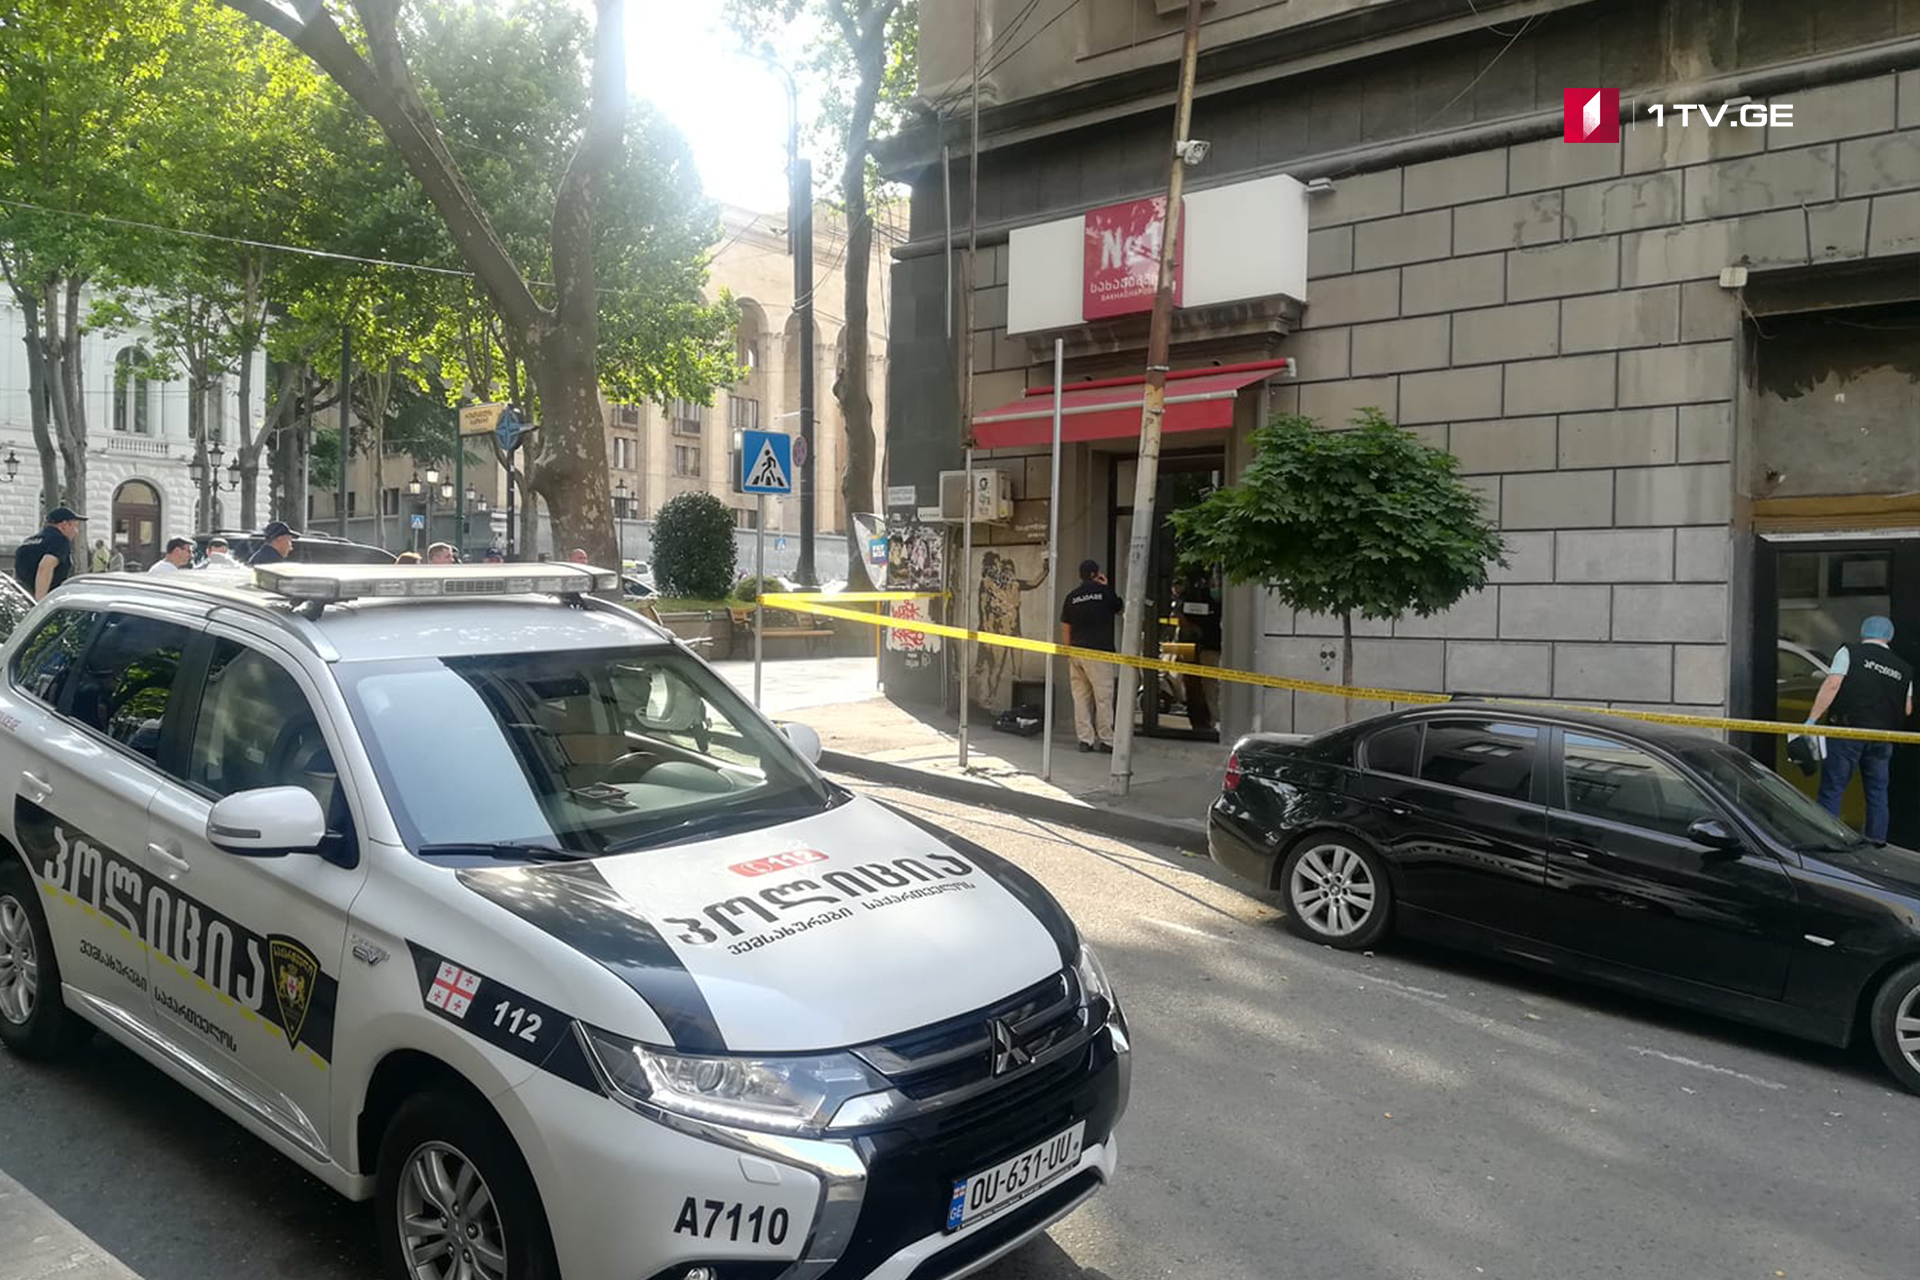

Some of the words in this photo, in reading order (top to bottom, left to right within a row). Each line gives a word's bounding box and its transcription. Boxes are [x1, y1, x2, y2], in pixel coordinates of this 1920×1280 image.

[44, 826, 265, 1011] პოლიცია
[663, 853, 973, 945] პოლიცია
[727, 907, 854, 956] ვემსახურები
[861, 881, 976, 911] საქართველოს
[79, 939, 148, 991] ვემსახურები
[154, 986, 237, 1052] საქართველოს
[493, 1000, 543, 1043] 112
[970, 1132, 1073, 1211] OU-631-UU
[673, 1196, 789, 1246] A7110
[950, 1203, 963, 1221] GE
